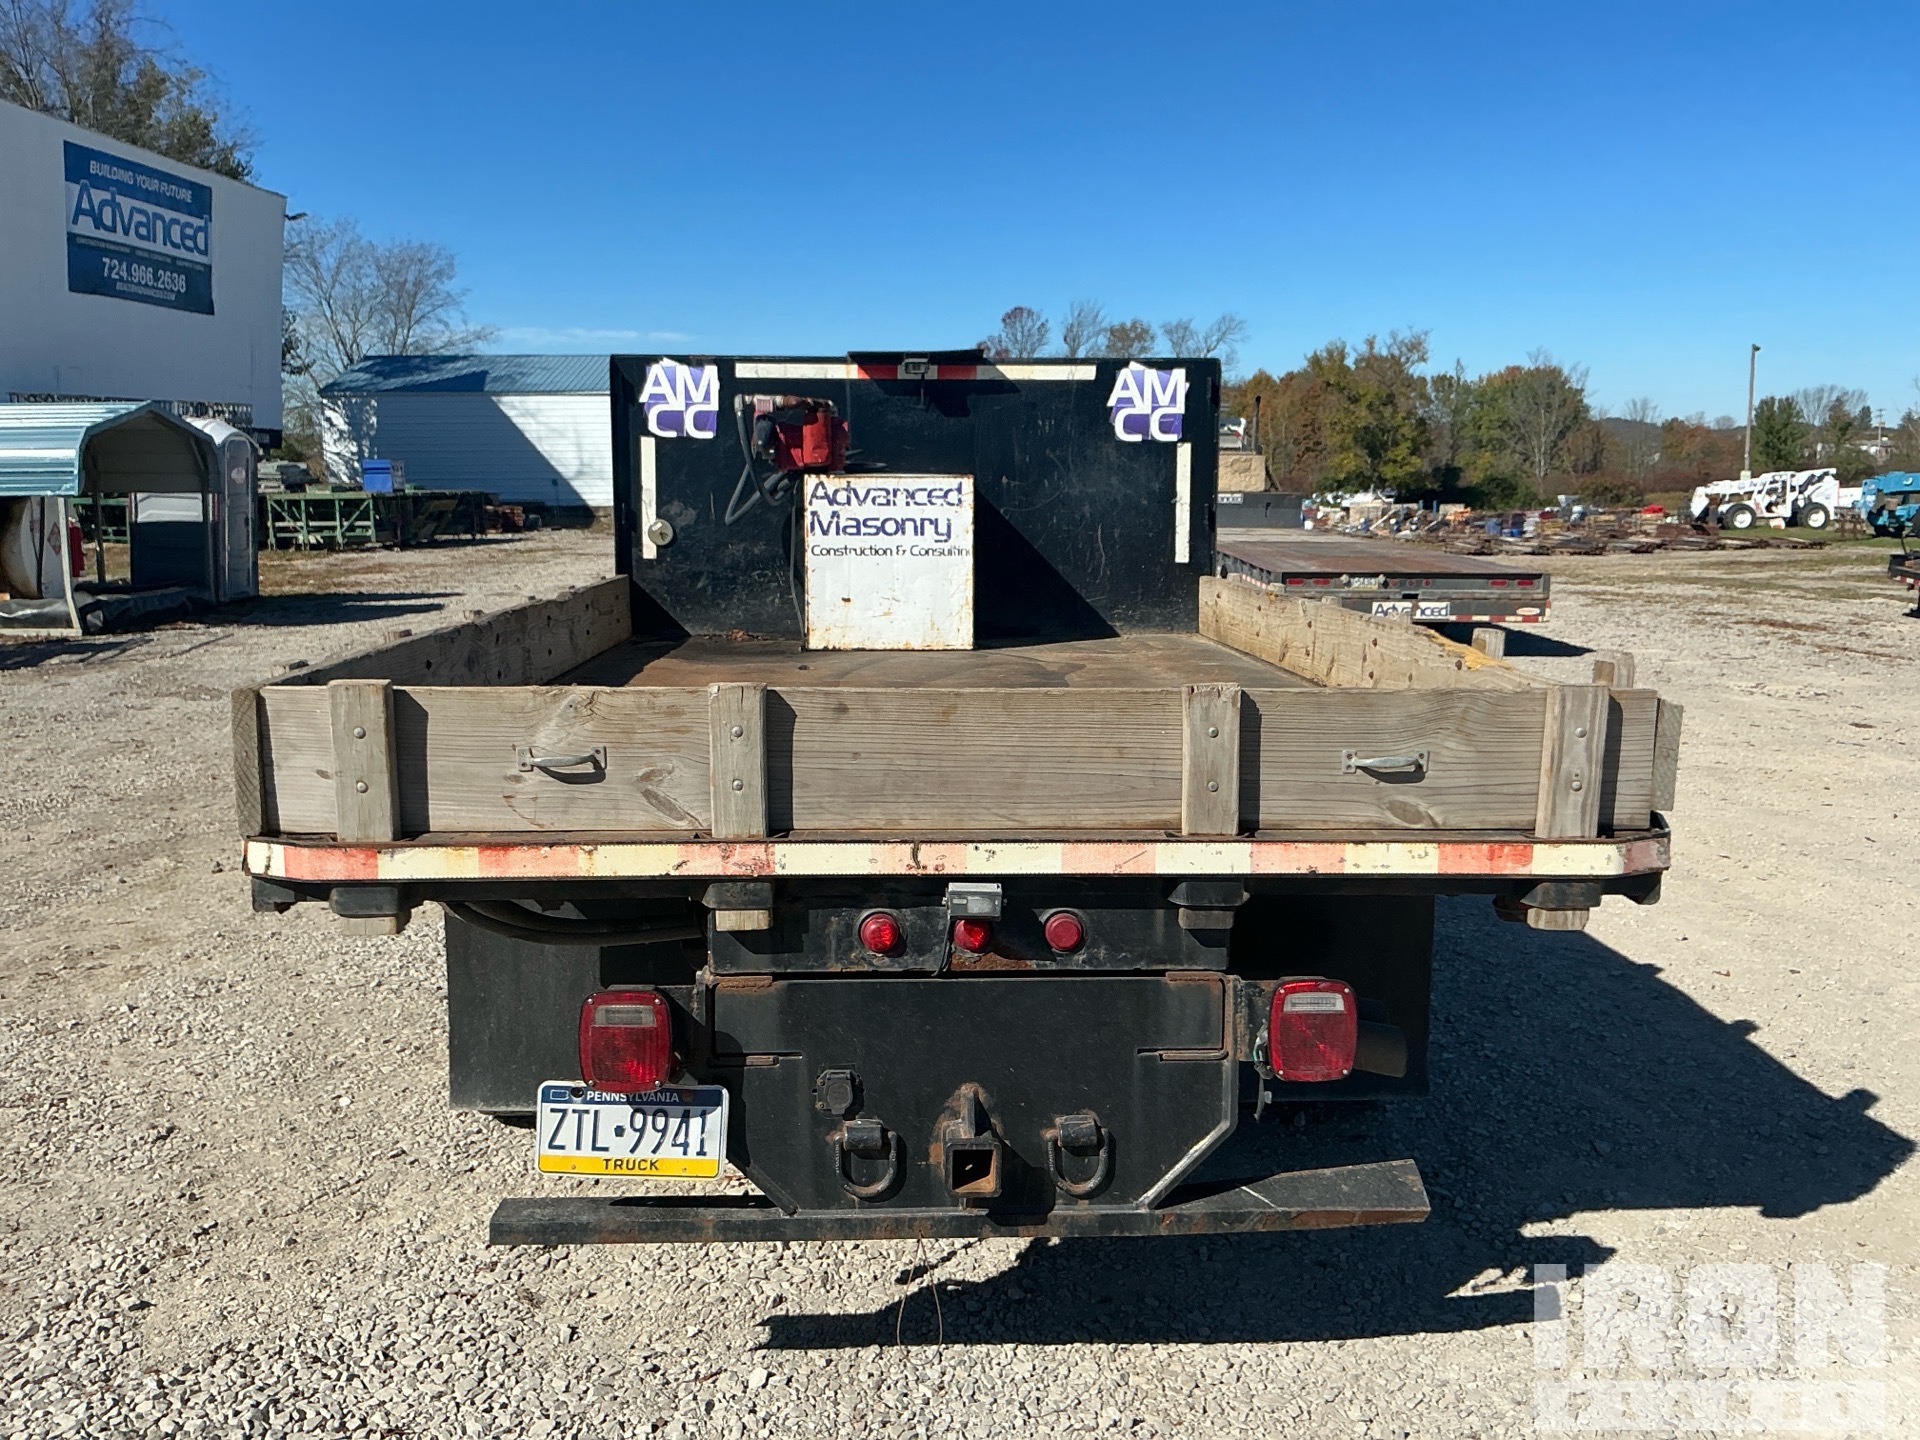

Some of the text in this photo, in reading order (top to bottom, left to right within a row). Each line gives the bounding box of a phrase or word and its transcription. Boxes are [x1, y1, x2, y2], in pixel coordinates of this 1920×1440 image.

[90, 160, 193, 203] BUILDING YOUR FUTURE
[71, 179, 210, 257] Advanced
[808, 480, 963, 507] Advanced
[809, 510, 952, 543] Masonry
[811, 544, 971, 557] Construction & Consultin
[586, 1090, 680, 1103] PENNSYLVANIA
[547, 1107, 708, 1156] ZTL 9941
[603, 1158, 660, 1171] TRUCK
